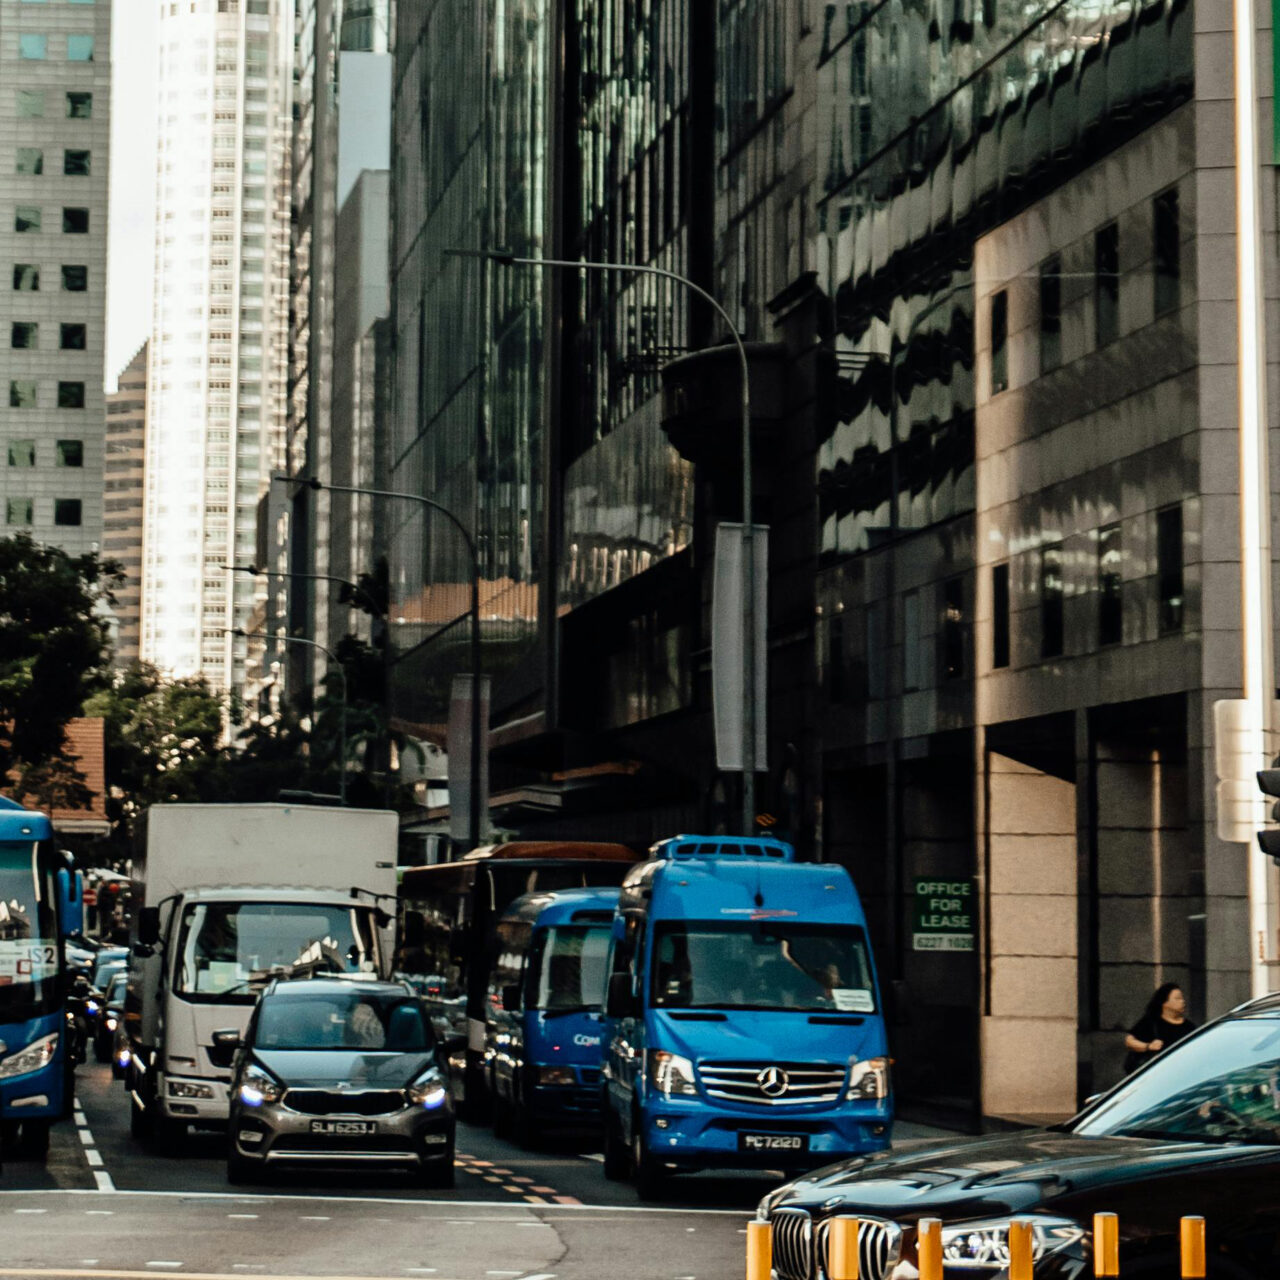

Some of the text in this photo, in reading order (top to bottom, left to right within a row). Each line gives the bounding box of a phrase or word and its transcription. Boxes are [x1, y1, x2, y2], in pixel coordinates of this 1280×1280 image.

[916, 882, 971, 895] OFFICE
[930, 898, 962, 911] FOR
[921, 914, 971, 928] LEASE
